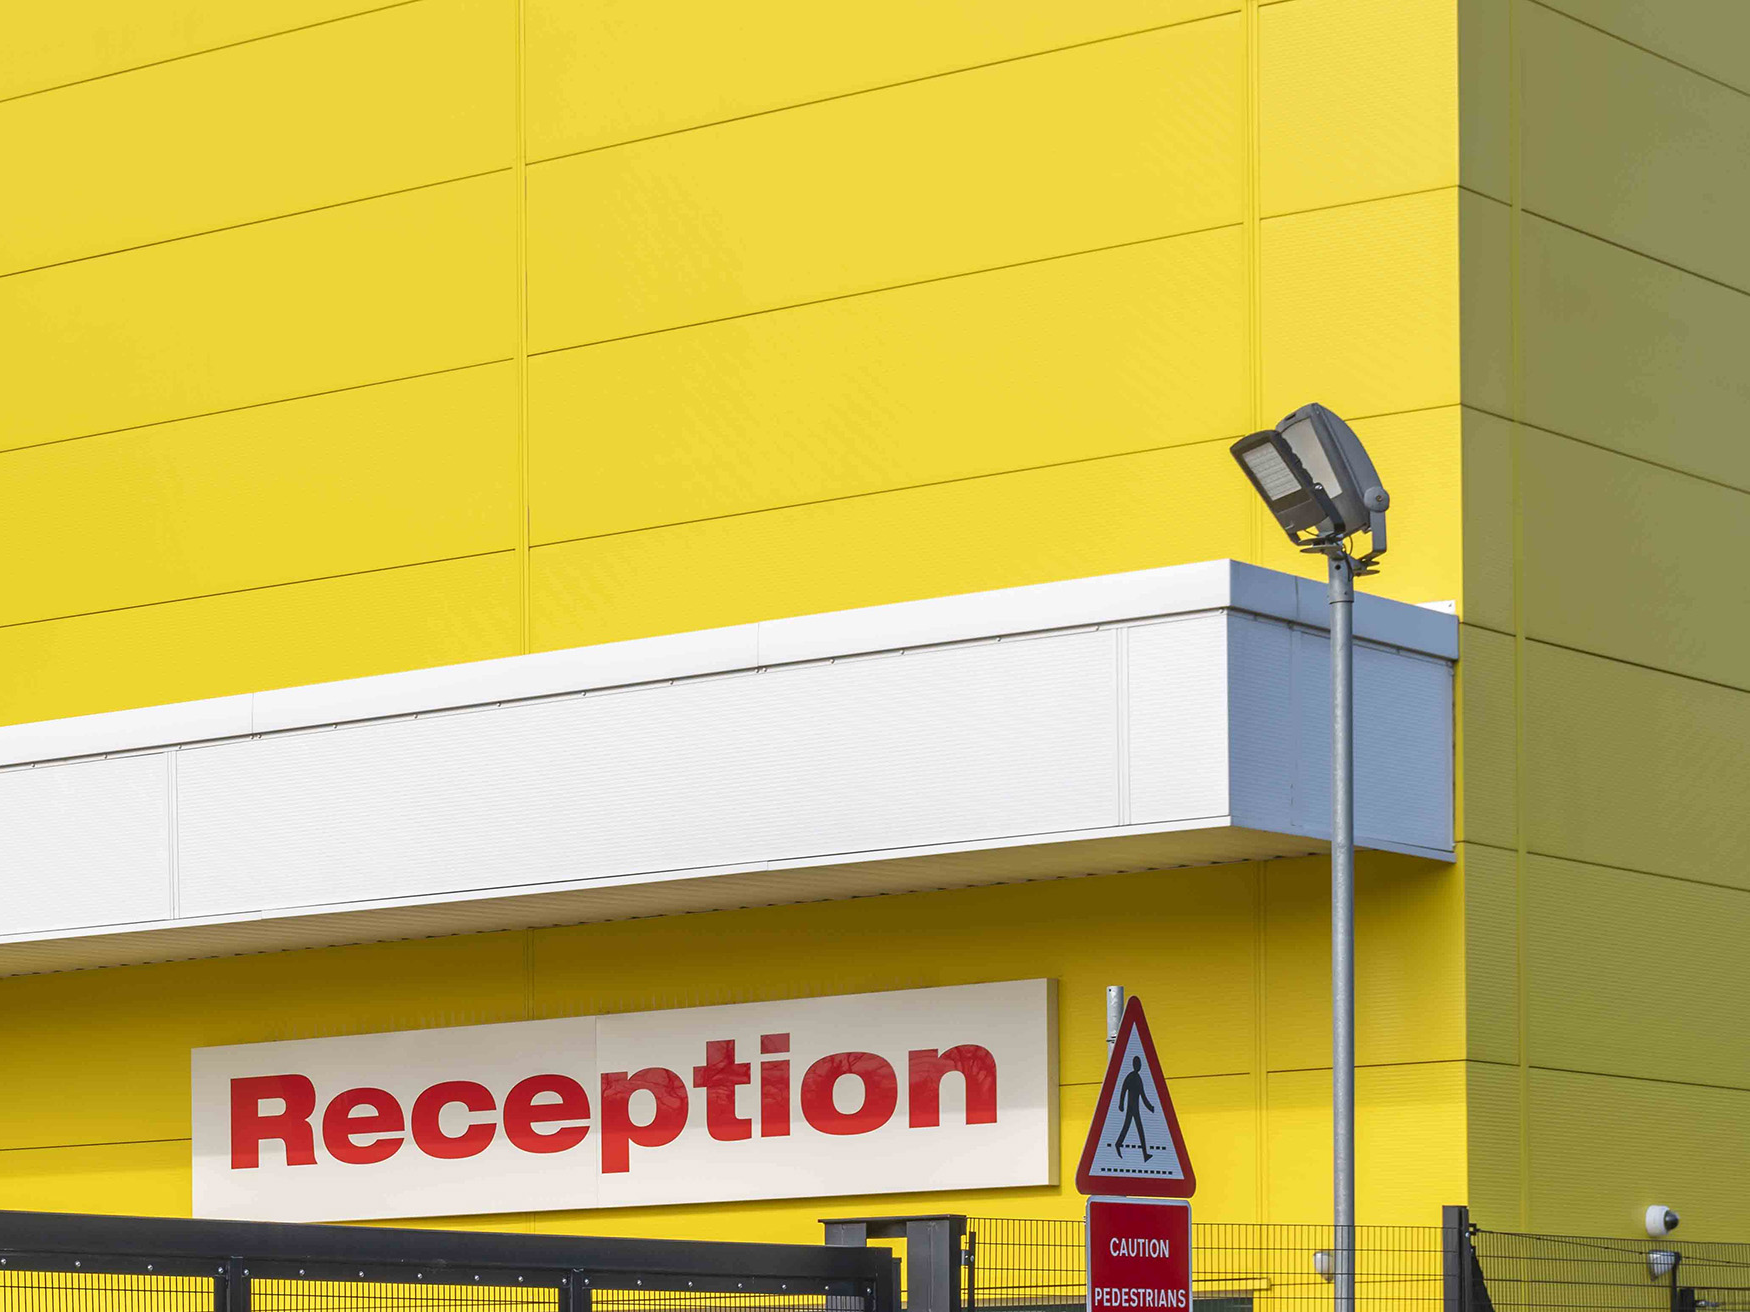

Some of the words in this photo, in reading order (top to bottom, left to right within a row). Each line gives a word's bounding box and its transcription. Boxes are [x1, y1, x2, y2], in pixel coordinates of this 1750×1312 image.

[230, 1032, 998, 1173] Reception
[1110, 1237, 1170, 1258] CAUTION
[1094, 1287, 1186, 1308] PEDESTRIANS
